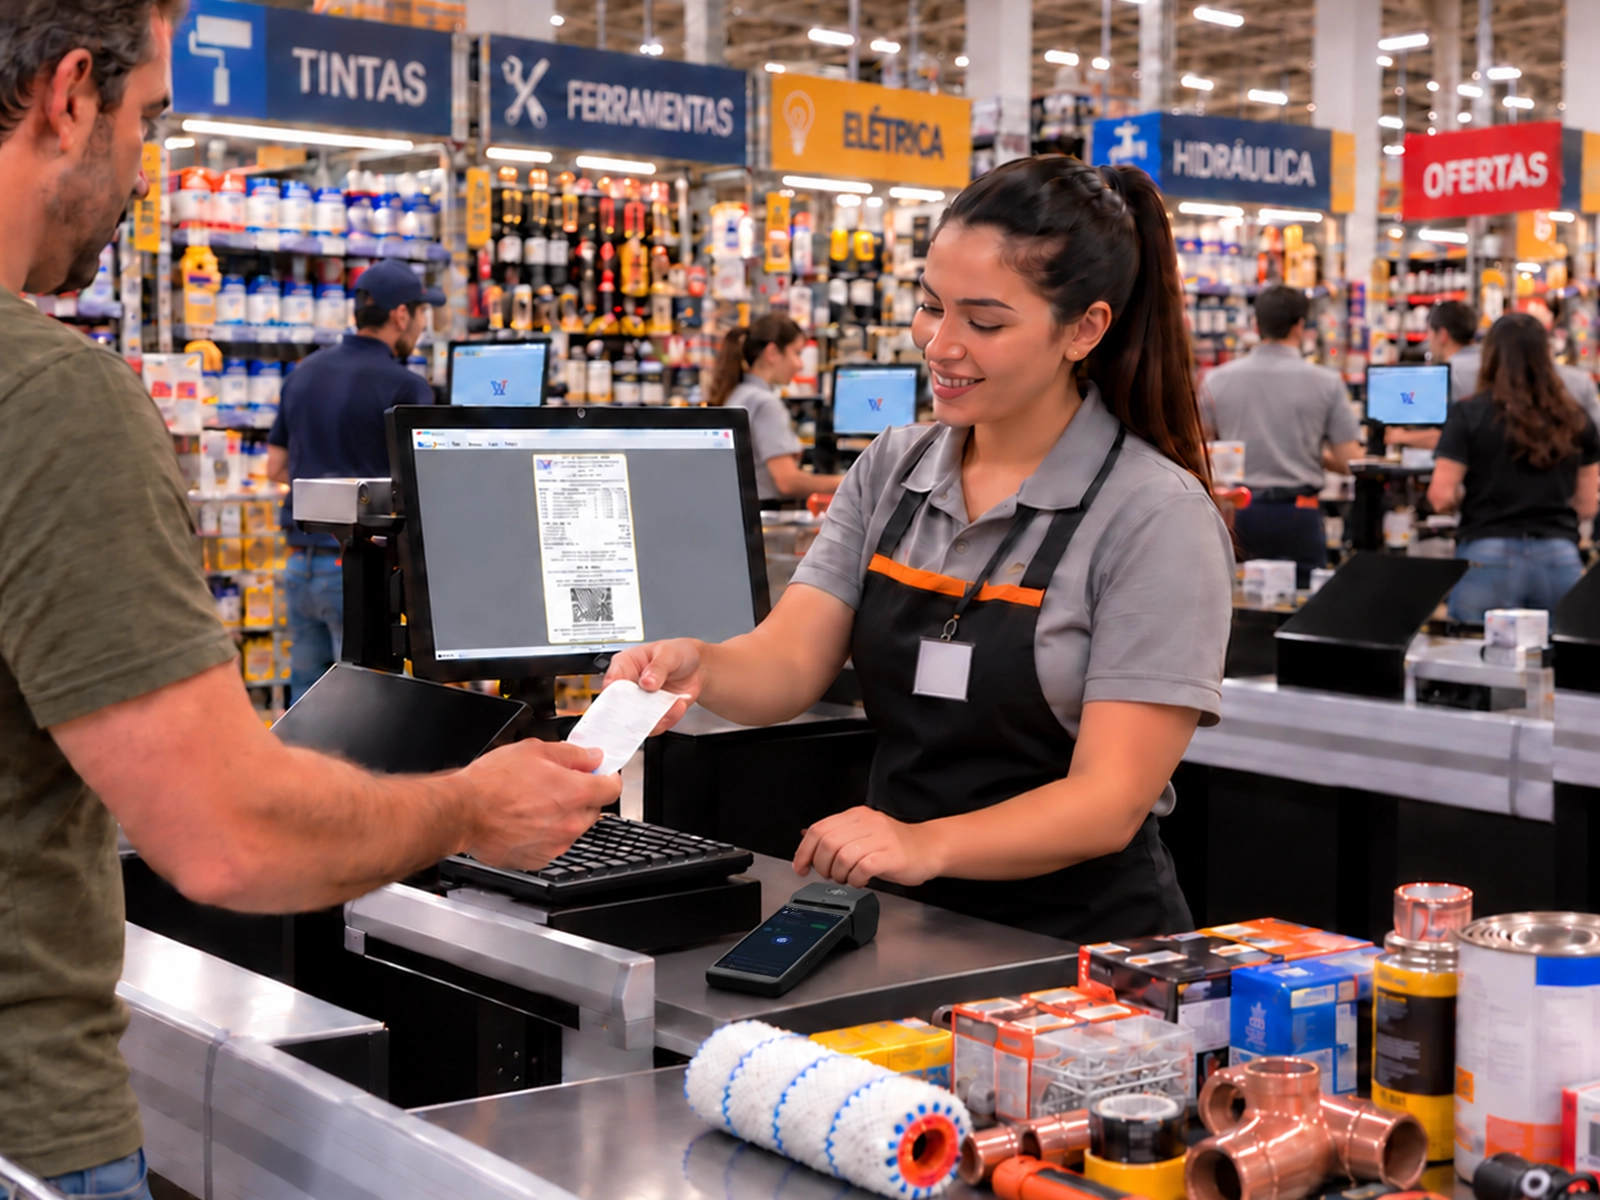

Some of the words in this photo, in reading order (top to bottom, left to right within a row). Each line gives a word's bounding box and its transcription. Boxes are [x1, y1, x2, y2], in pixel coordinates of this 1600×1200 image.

[292, 46, 427, 107] TINTAS
[567, 79, 734, 137] FERRAMENTAS
[844, 104, 945, 161] ELÉTRICA
[1172, 138, 1317, 188] HIDRÁULICA
[1423, 151, 1549, 199] OFERTAS
